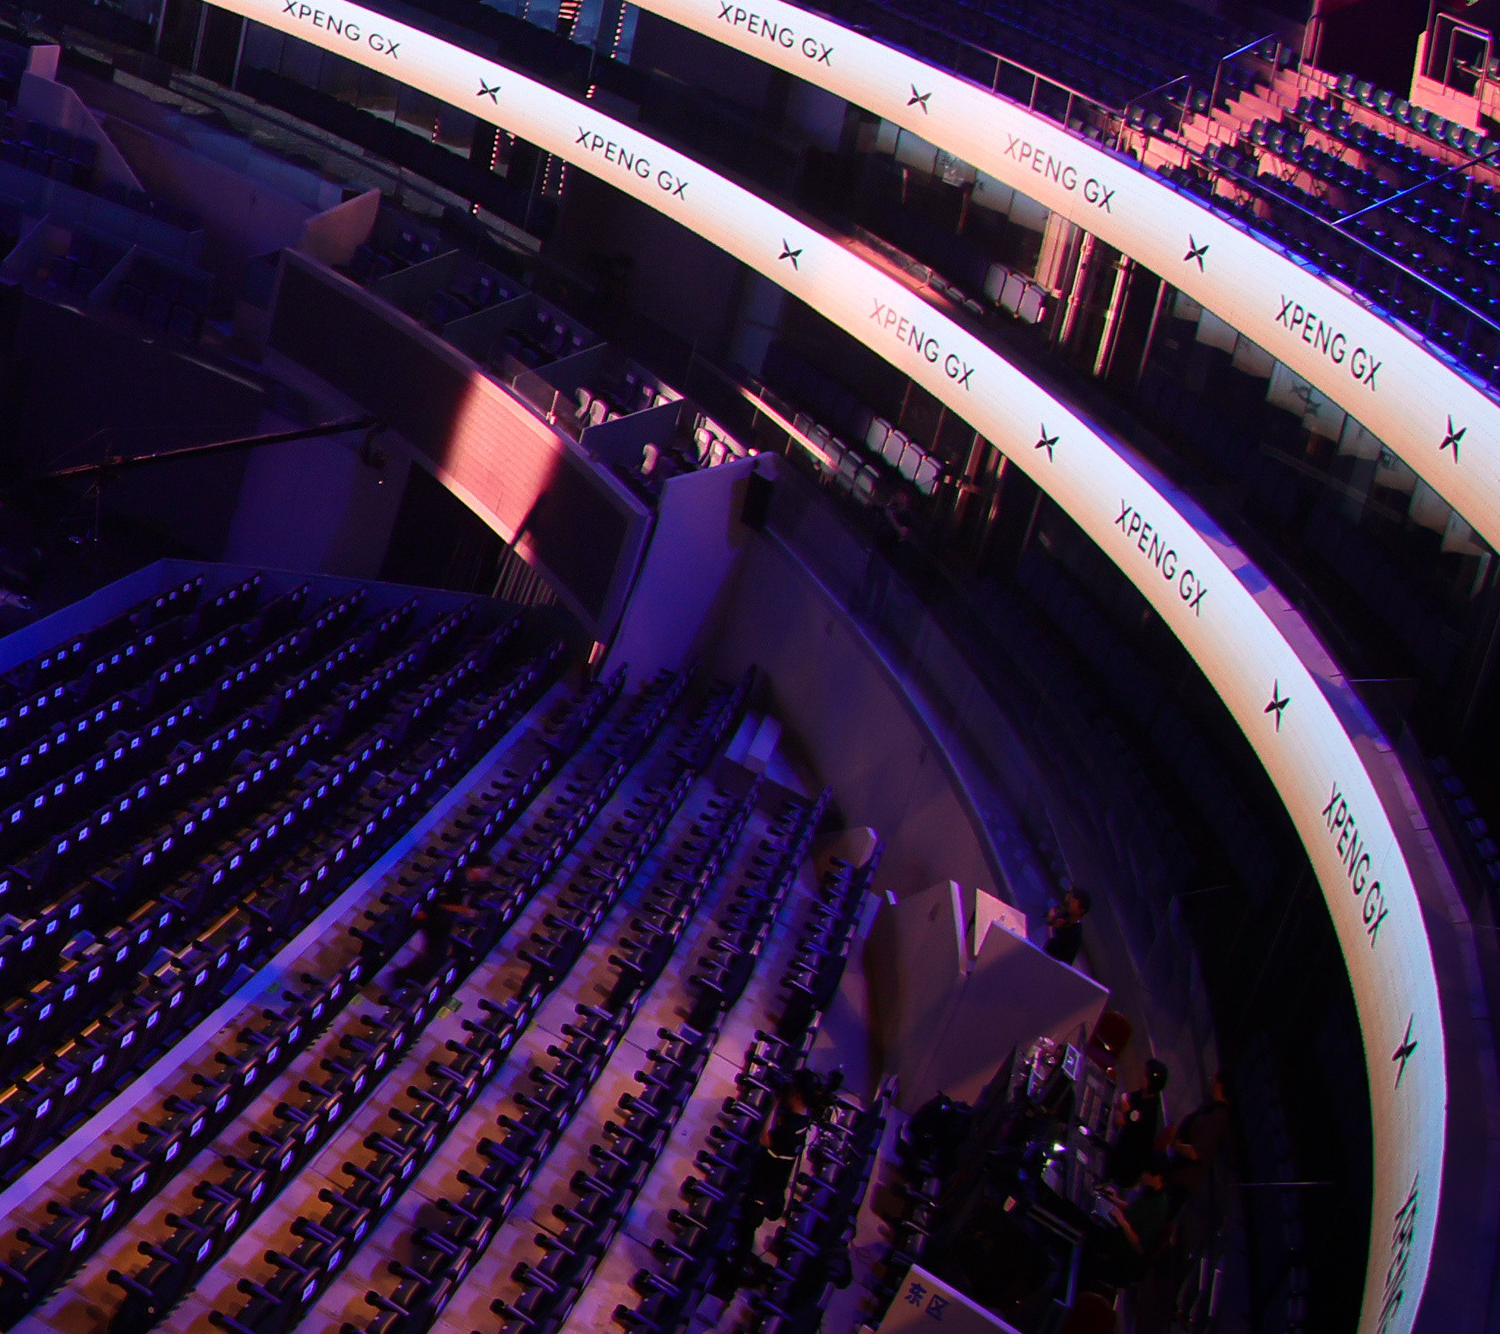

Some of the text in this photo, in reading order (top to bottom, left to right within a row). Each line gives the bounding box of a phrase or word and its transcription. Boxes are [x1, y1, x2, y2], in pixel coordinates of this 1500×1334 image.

[368, 33, 401, 60] GX
[717, 0, 834, 67] XPENG GX
[574, 126, 689, 201] XPENG GX
[1003, 133, 1115, 214] XPENG GX
[869, 299, 975, 391] XPENG GX
[1274, 294, 1382, 392] XPENG GX
[1114, 499, 1208, 617] XPENG GX
[1321, 781, 1389, 949] XPENG GX
[904, 1281, 950, 1322] 东区
